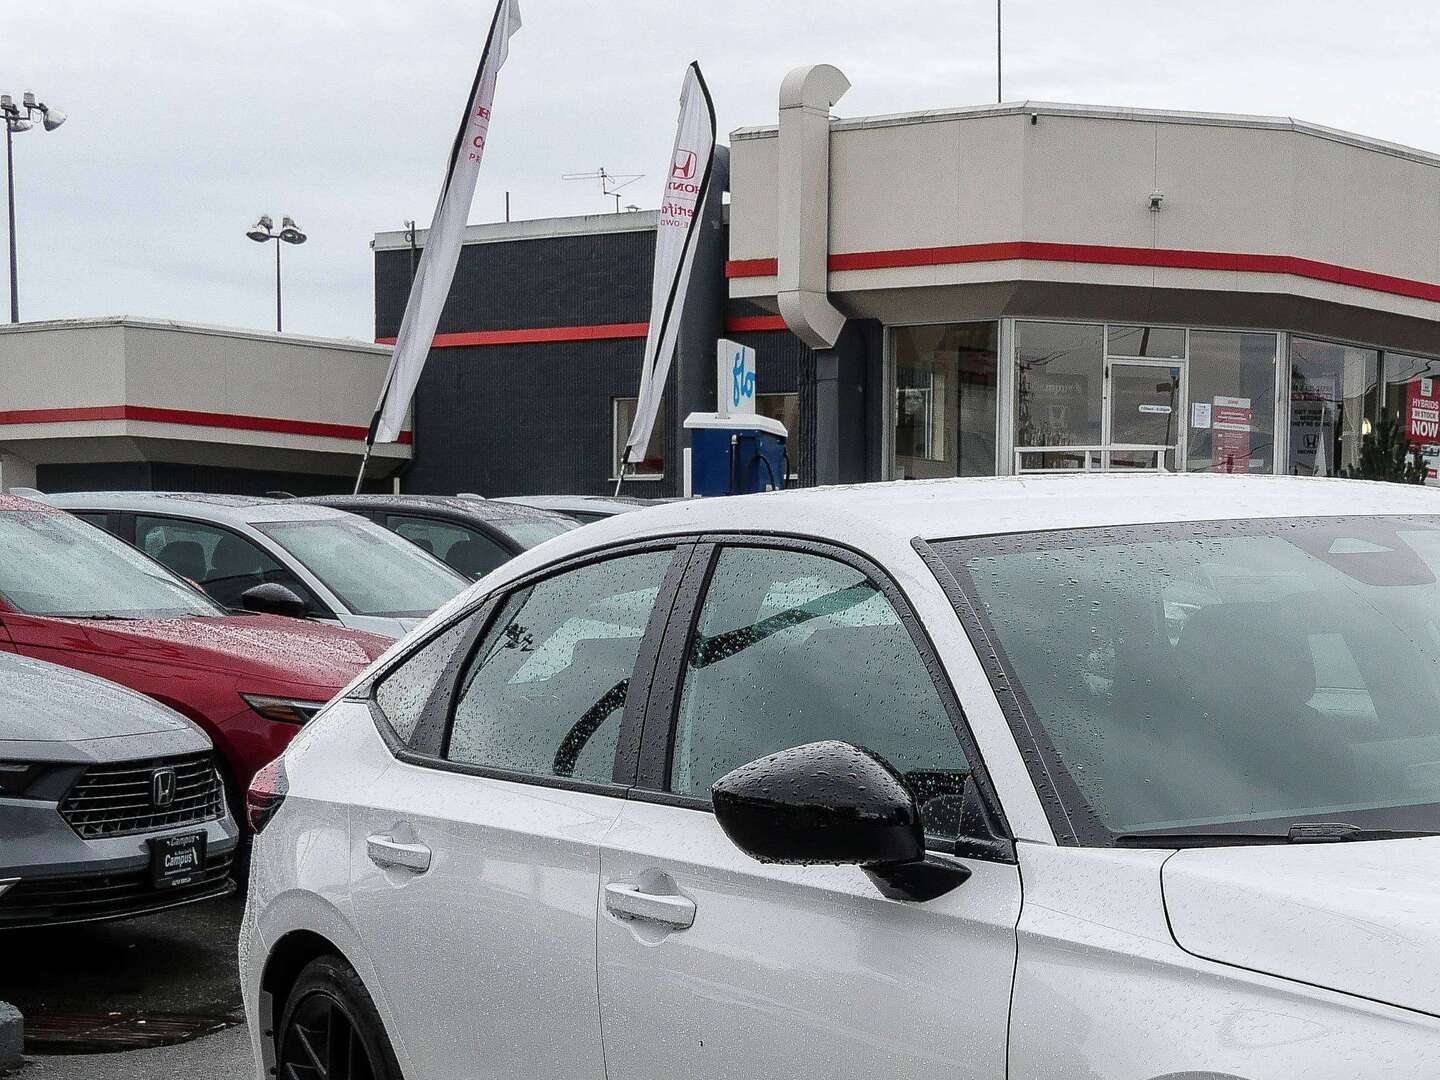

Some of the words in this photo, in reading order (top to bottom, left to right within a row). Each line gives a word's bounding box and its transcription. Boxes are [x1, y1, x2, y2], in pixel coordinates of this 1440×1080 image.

[733, 346, 758, 407] flo
[1412, 398, 1439, 410] HYBRIDS
[1411, 421, 1439, 438] NOW
[165, 853, 192, 867] Campus
